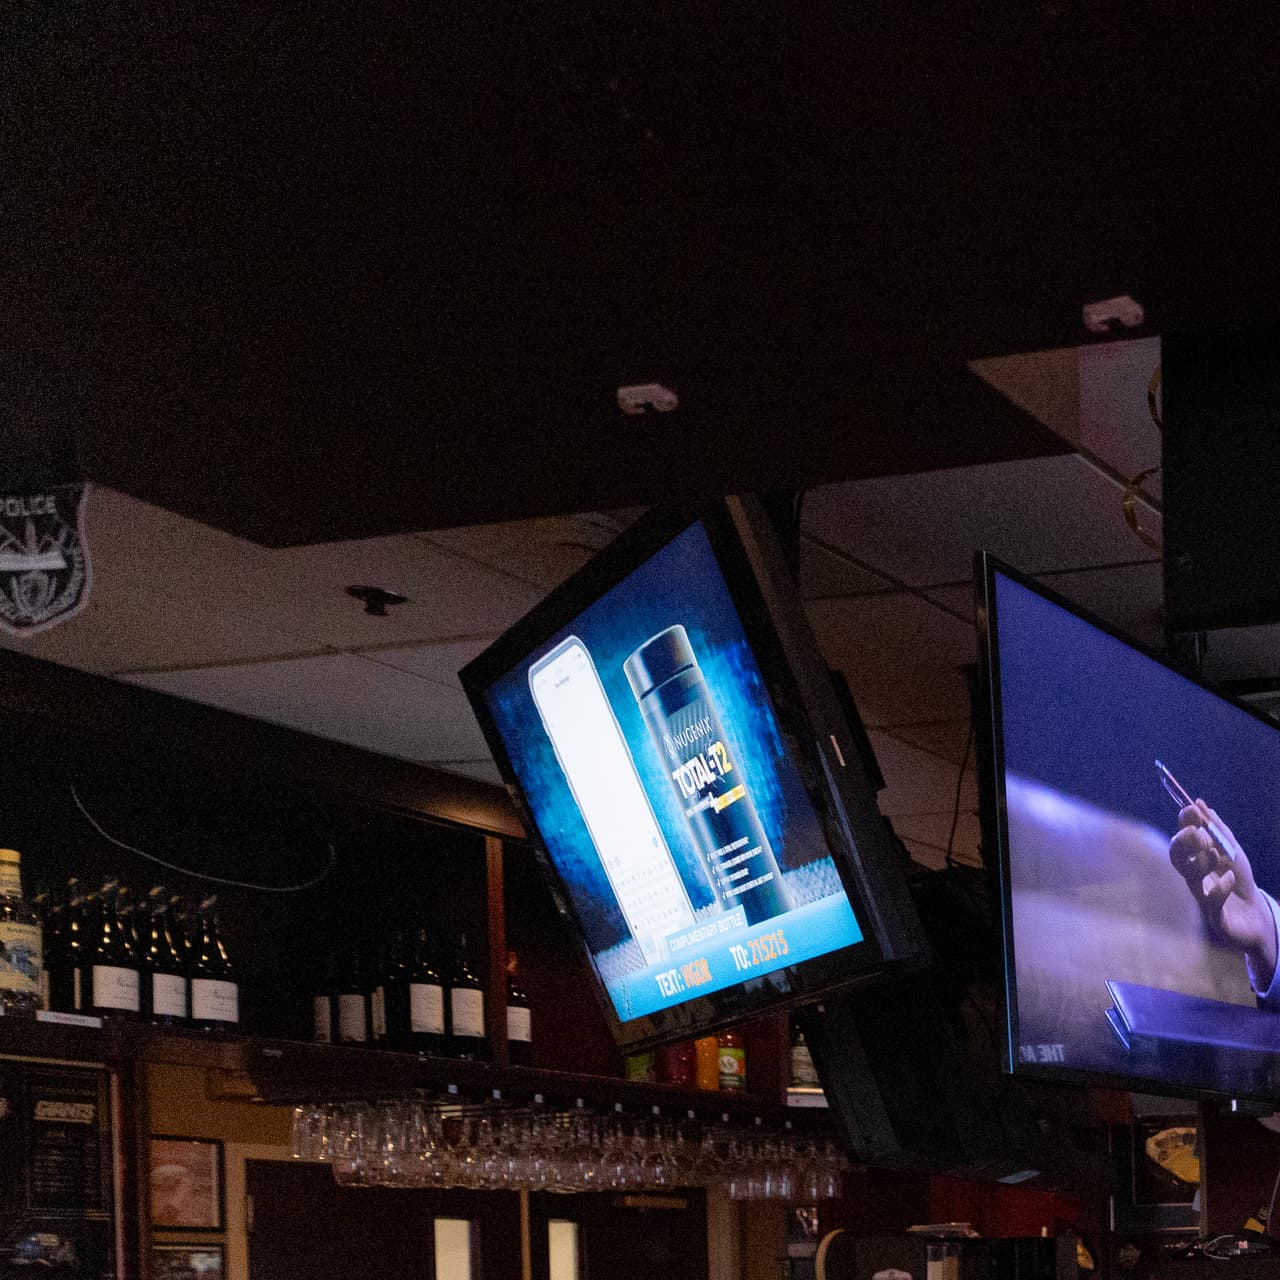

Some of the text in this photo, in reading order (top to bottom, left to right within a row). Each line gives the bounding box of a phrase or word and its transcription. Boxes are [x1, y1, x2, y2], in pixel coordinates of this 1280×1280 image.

[0, 496, 56, 517] OLICE
[673, 717, 713, 749] NUGENIX
[672, 740, 733, 799] TOTAL-T2
[669, 911, 745, 951] COMPLIMENTARY BOTTLE
[655, 929, 789, 998] TEXT: VIGOR TO: 215215
